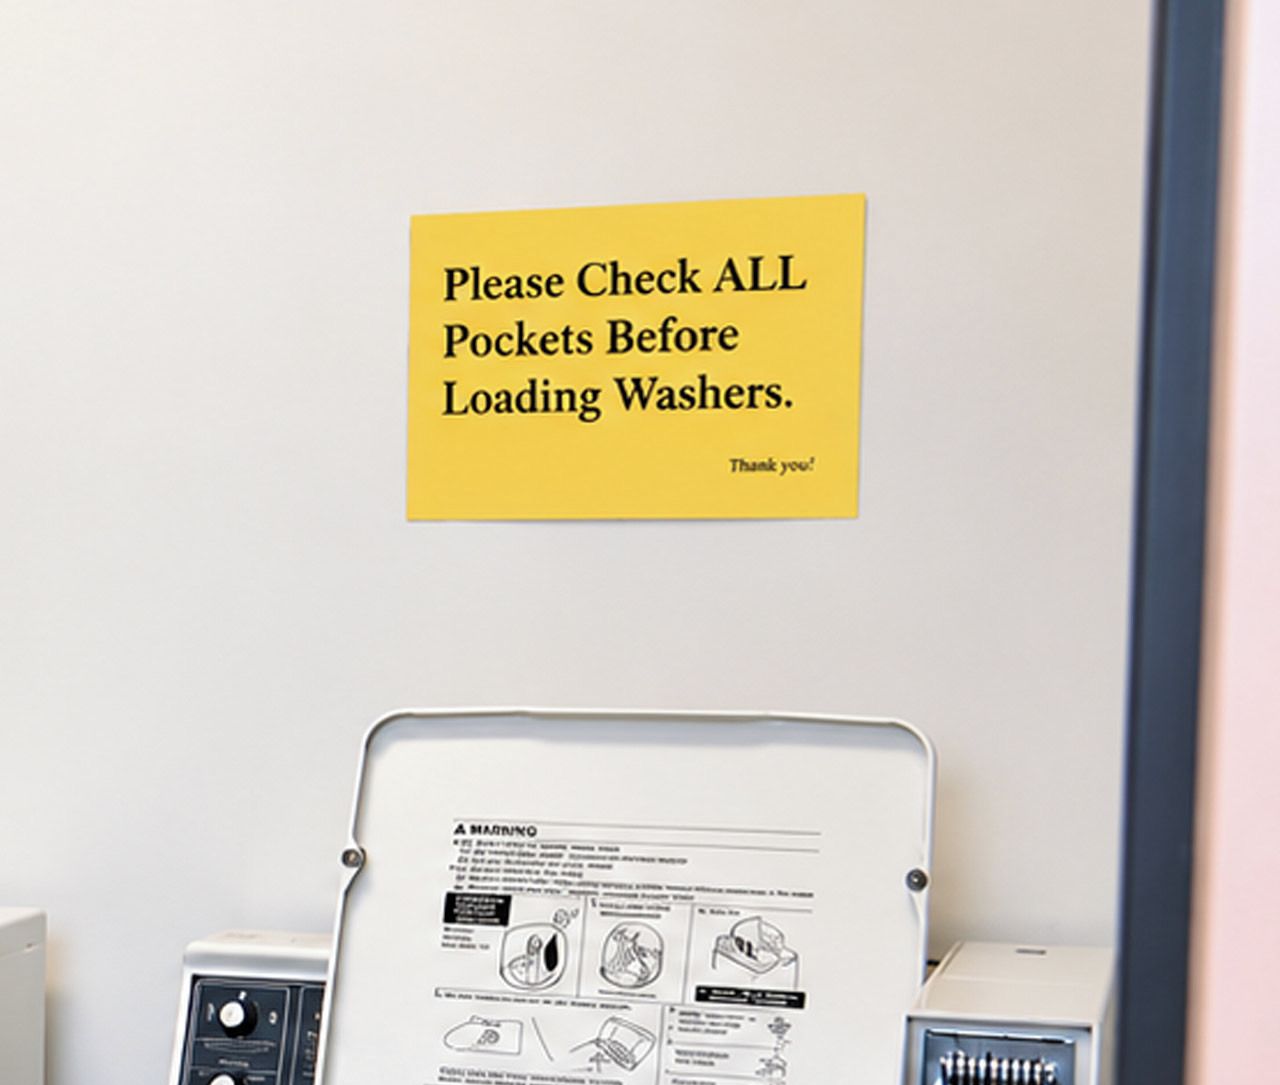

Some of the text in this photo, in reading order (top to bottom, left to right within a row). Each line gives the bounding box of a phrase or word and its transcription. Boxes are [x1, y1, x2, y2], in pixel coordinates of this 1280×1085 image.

[443, 254, 808, 302] Please Check ALL
[443, 315, 740, 359] Pockets Before
[441, 373, 793, 424] Loading Washers.
[729, 456, 815, 476] Thank you!
